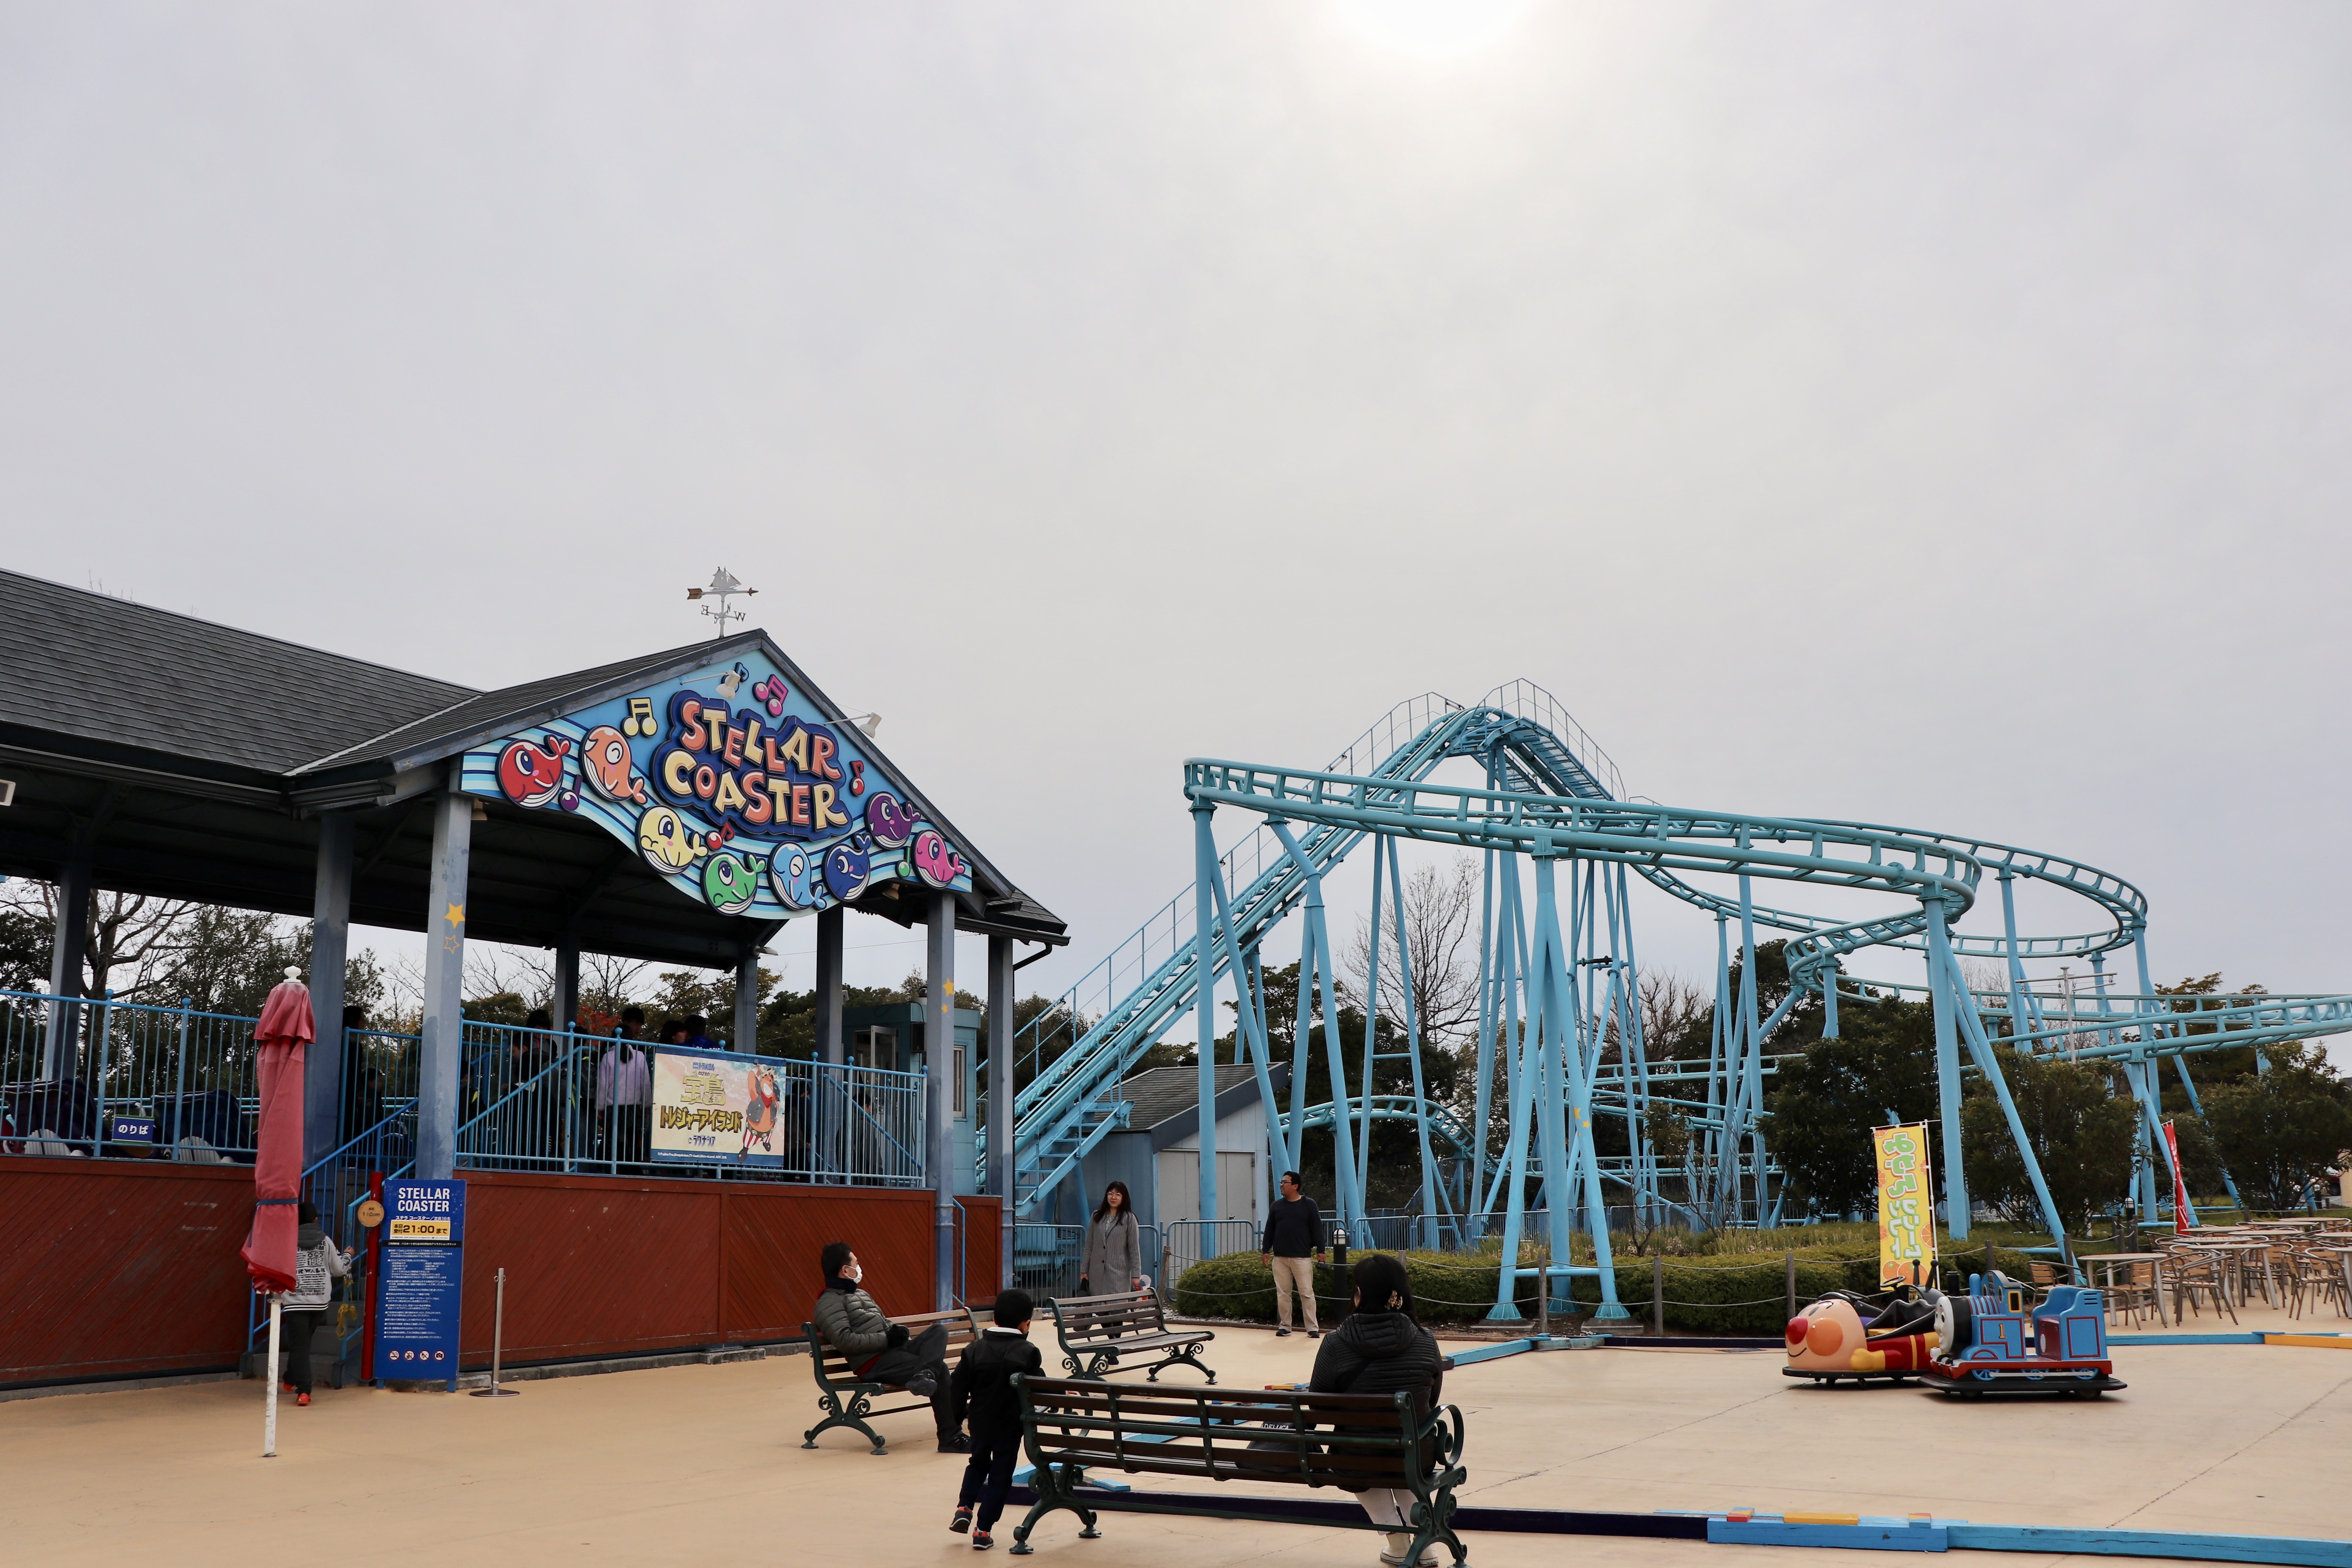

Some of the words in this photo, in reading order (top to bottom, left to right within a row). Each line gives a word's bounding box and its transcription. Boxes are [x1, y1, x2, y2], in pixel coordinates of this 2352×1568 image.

[734, 611, 746, 622] W
[680, 697, 842, 782] STELLAR
[663, 748, 849, 832] COASTER
[681, 1074, 726, 1106] 宝島
[661, 1105, 744, 1133] トレジャーアイランド
[118, 1124, 149, 1135] のりば
[398, 1187, 450, 1200] STELLAR
[397, 1200, 449, 1212] COASTER
[403, 1225, 435, 1234] 21:00
[1998, 1323, 2006, 1339] 1
